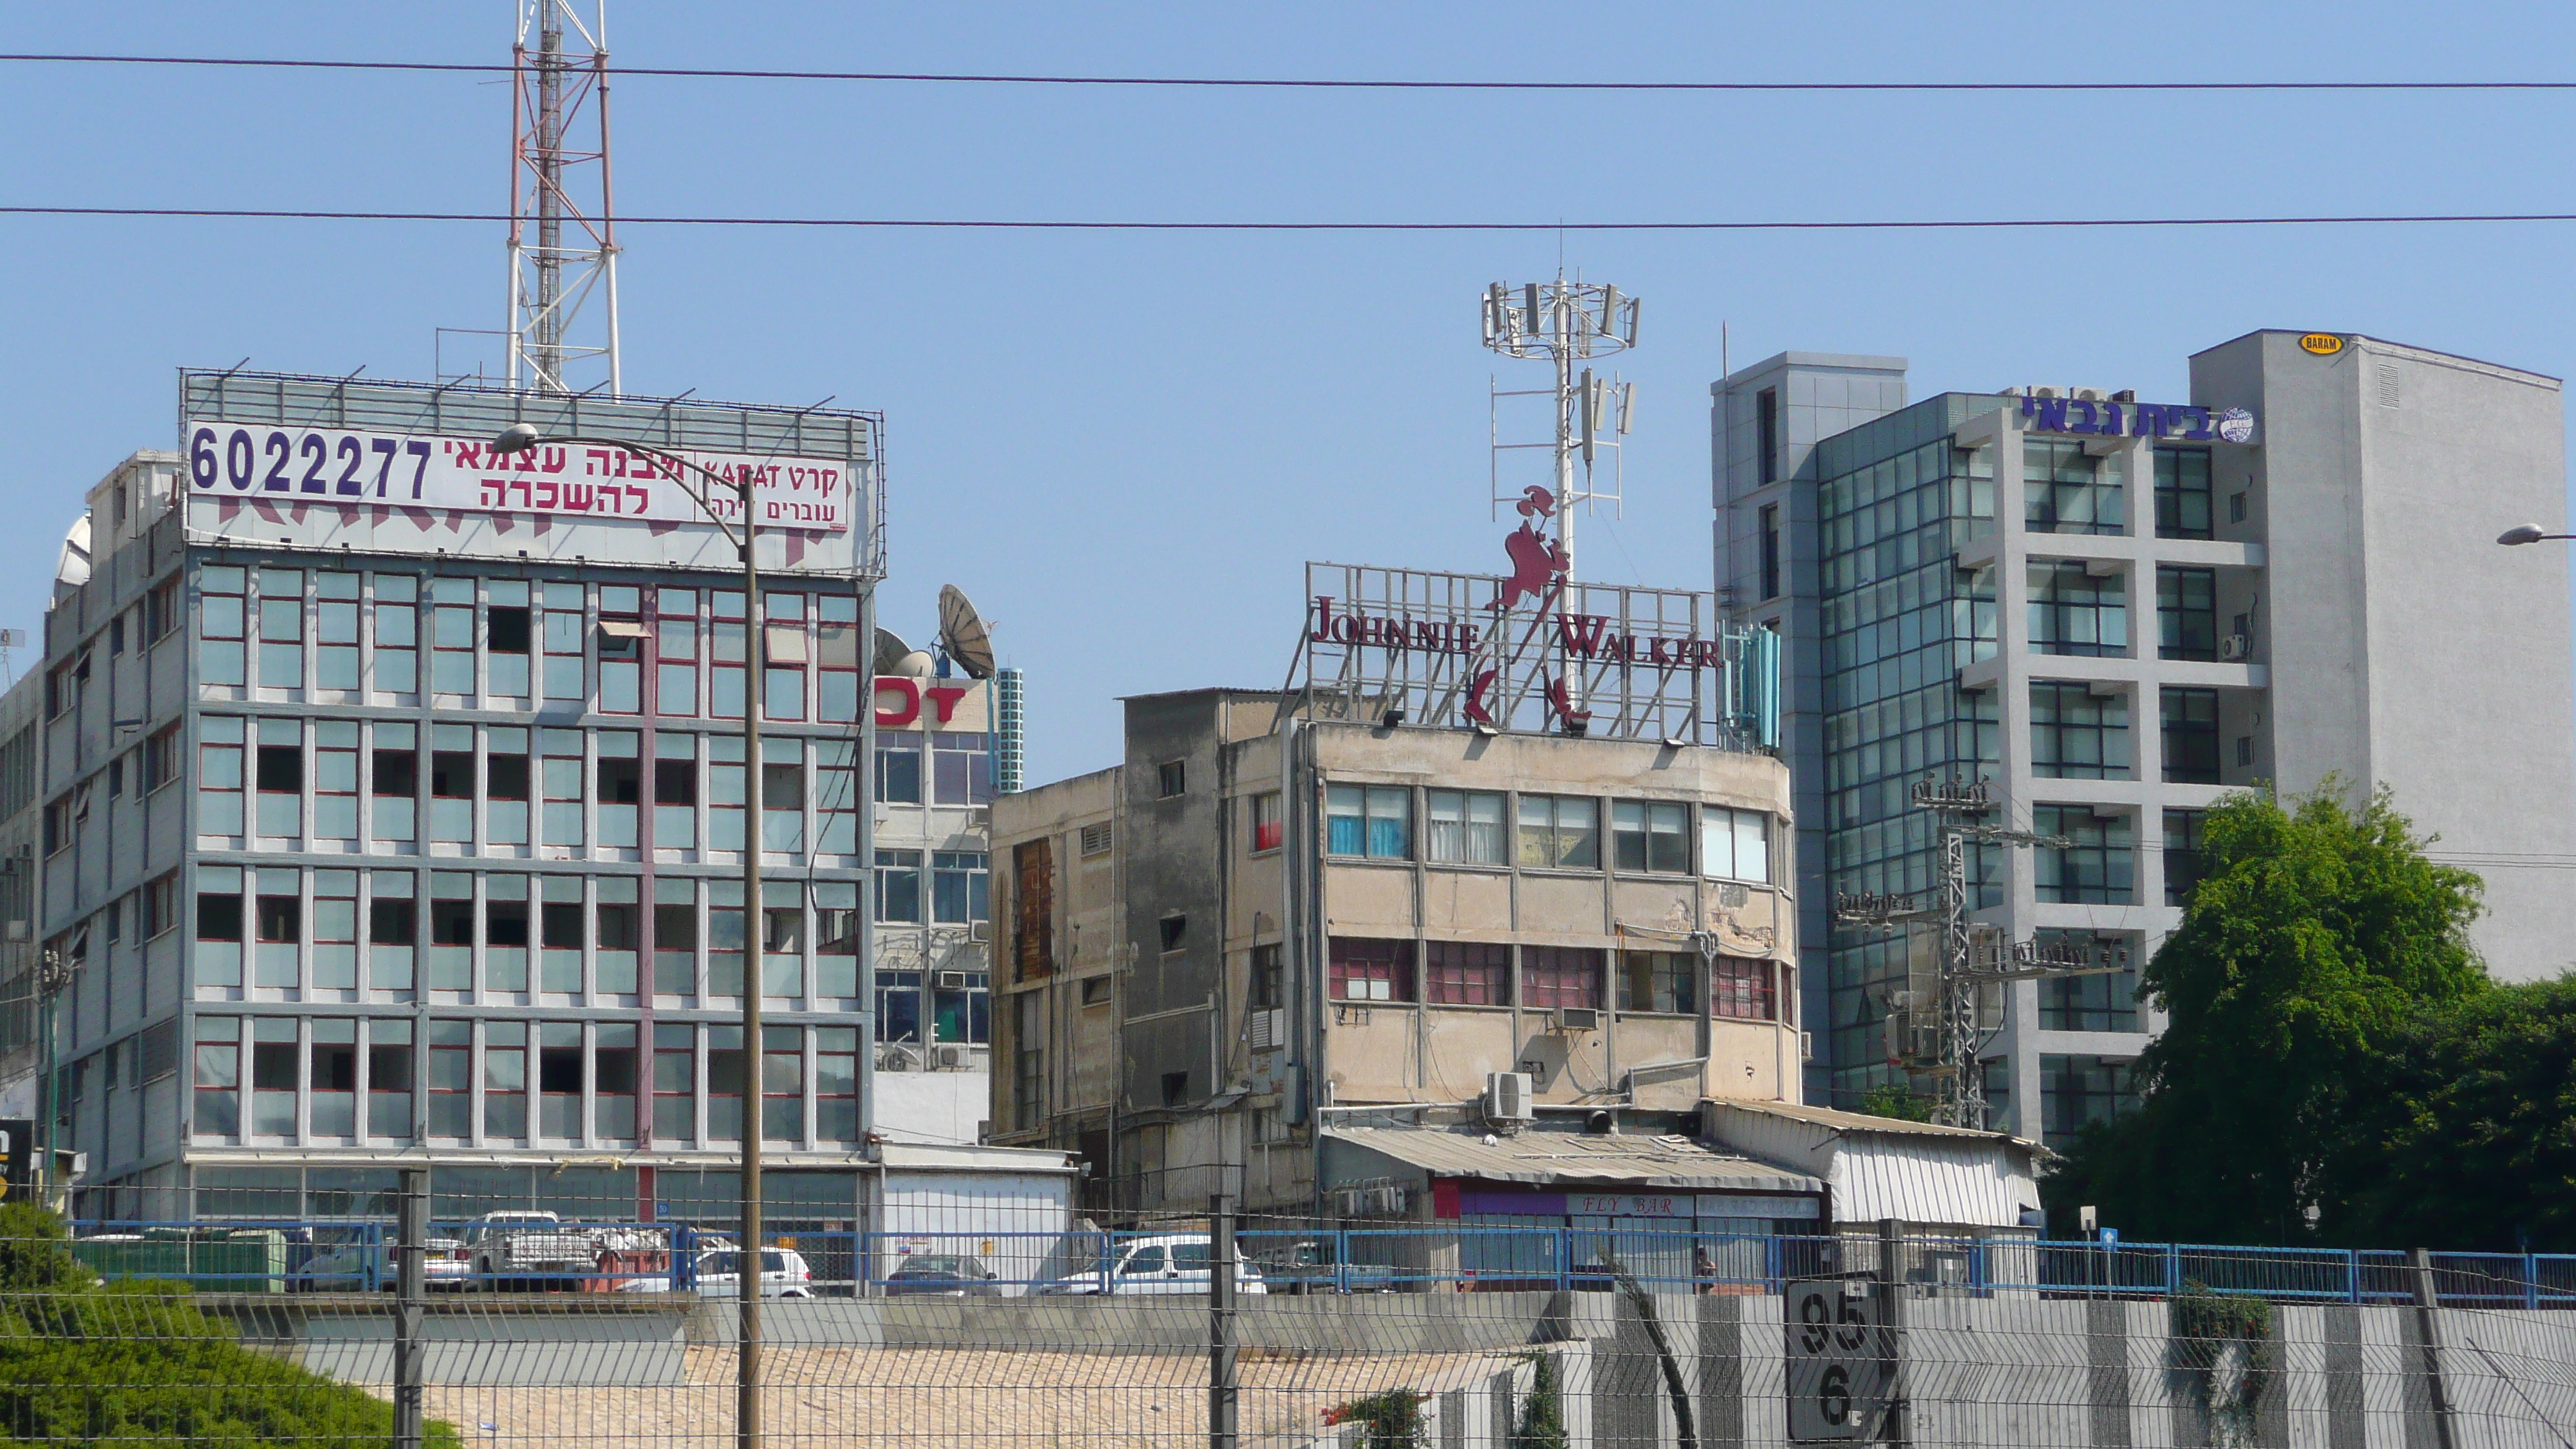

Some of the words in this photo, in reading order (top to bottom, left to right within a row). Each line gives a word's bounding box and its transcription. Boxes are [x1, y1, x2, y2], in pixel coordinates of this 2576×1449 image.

[2306, 336, 2337, 351] BARAM
[2022, 396, 2124, 436] גבאי
[2133, 402, 2212, 440] בית
[190, 426, 432, 500] 6022277
[787, 465, 839, 499] קרט
[480, 478, 649, 515] להשכרה
[766, 501, 835, 522] עוברים
[1310, 594, 1482, 655] JOHNNIE
[1553, 612, 1724, 669] WALKER
[1583, 1196, 1622, 1212] FLY
[1633, 1197, 1675, 1216] BAR
[1800, 1290, 1867, 1354] 95
[1820, 1364, 1852, 1426] 6
